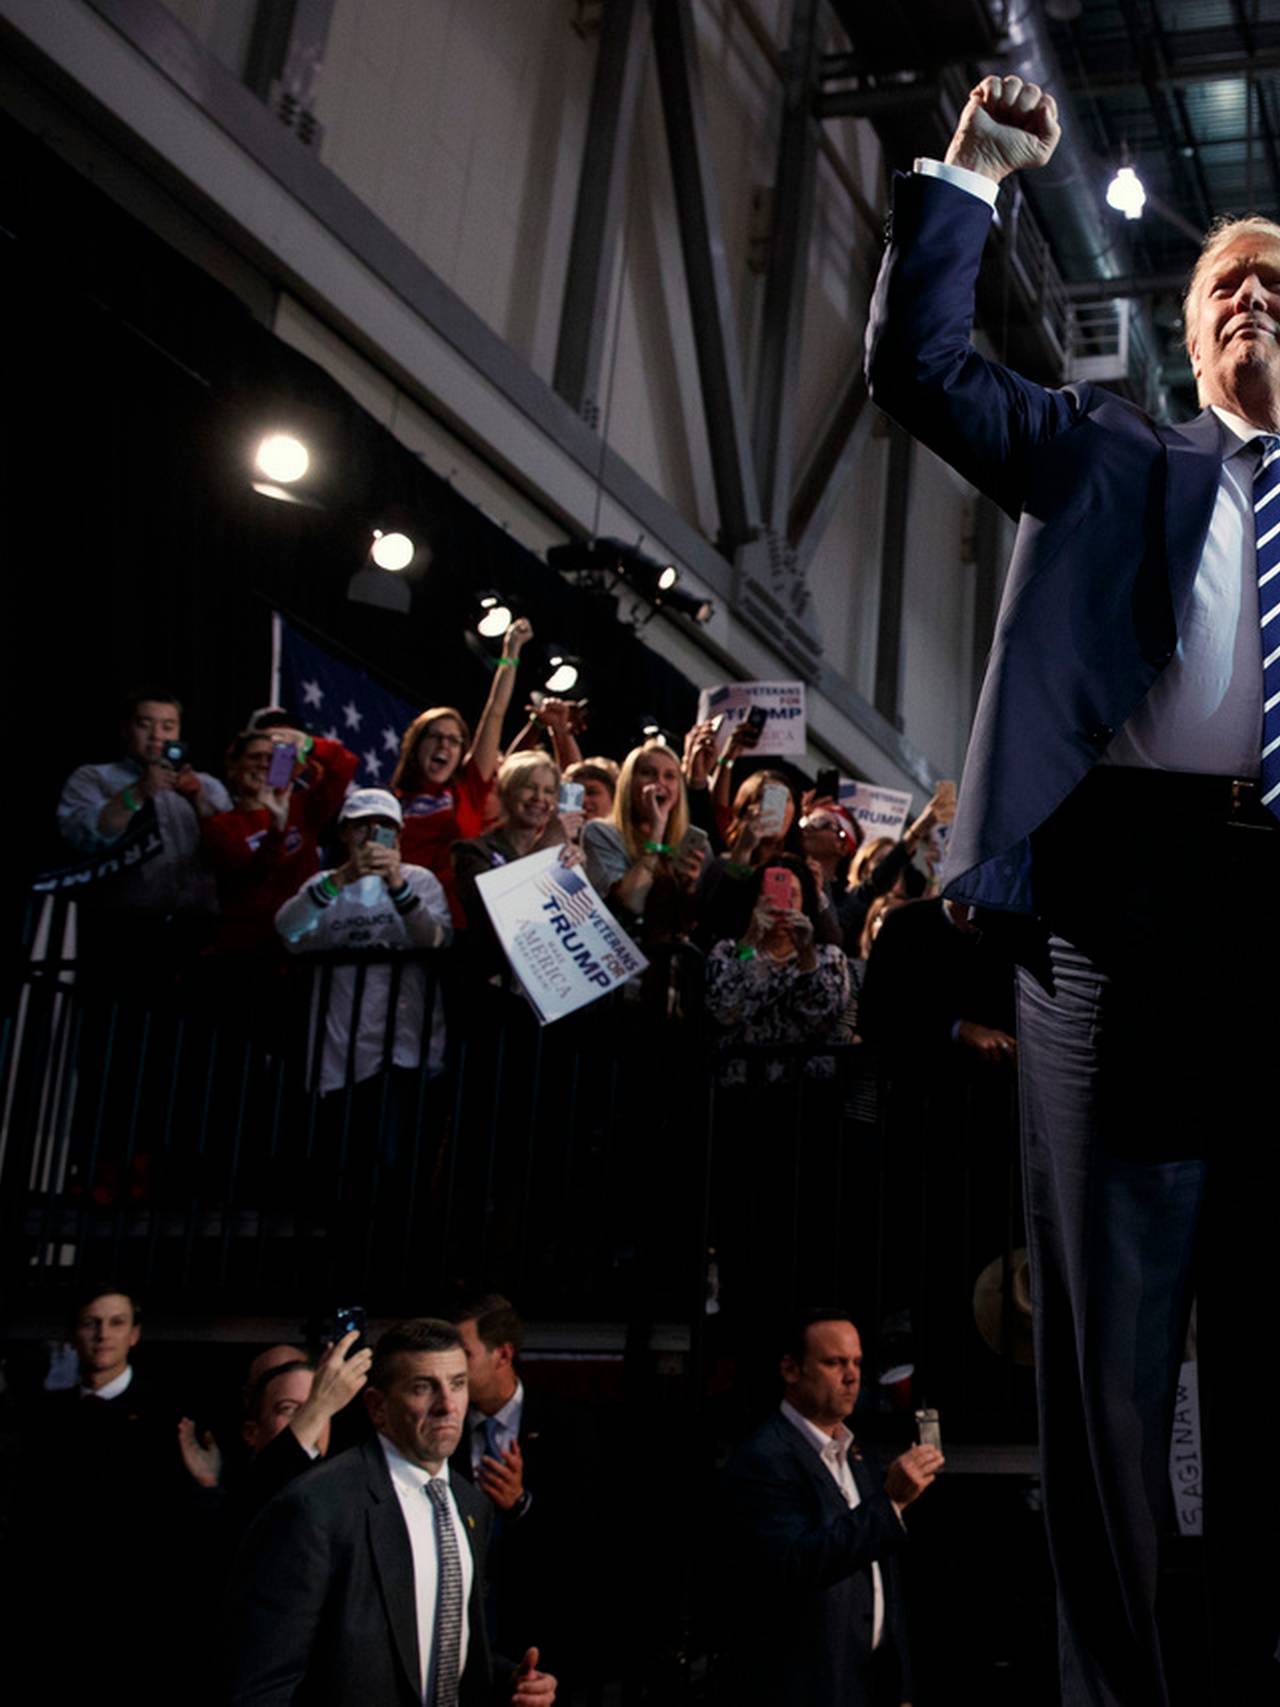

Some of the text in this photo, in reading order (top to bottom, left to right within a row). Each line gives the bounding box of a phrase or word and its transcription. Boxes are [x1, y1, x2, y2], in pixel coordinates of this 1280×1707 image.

[516, 918, 573, 999] AMERICA
[543, 896, 611, 989] TRUMP
[588, 909, 639, 972] VETERANS
[601, 953, 626, 979] FOR
[1174, 1385, 1204, 1526] SAGINAW
